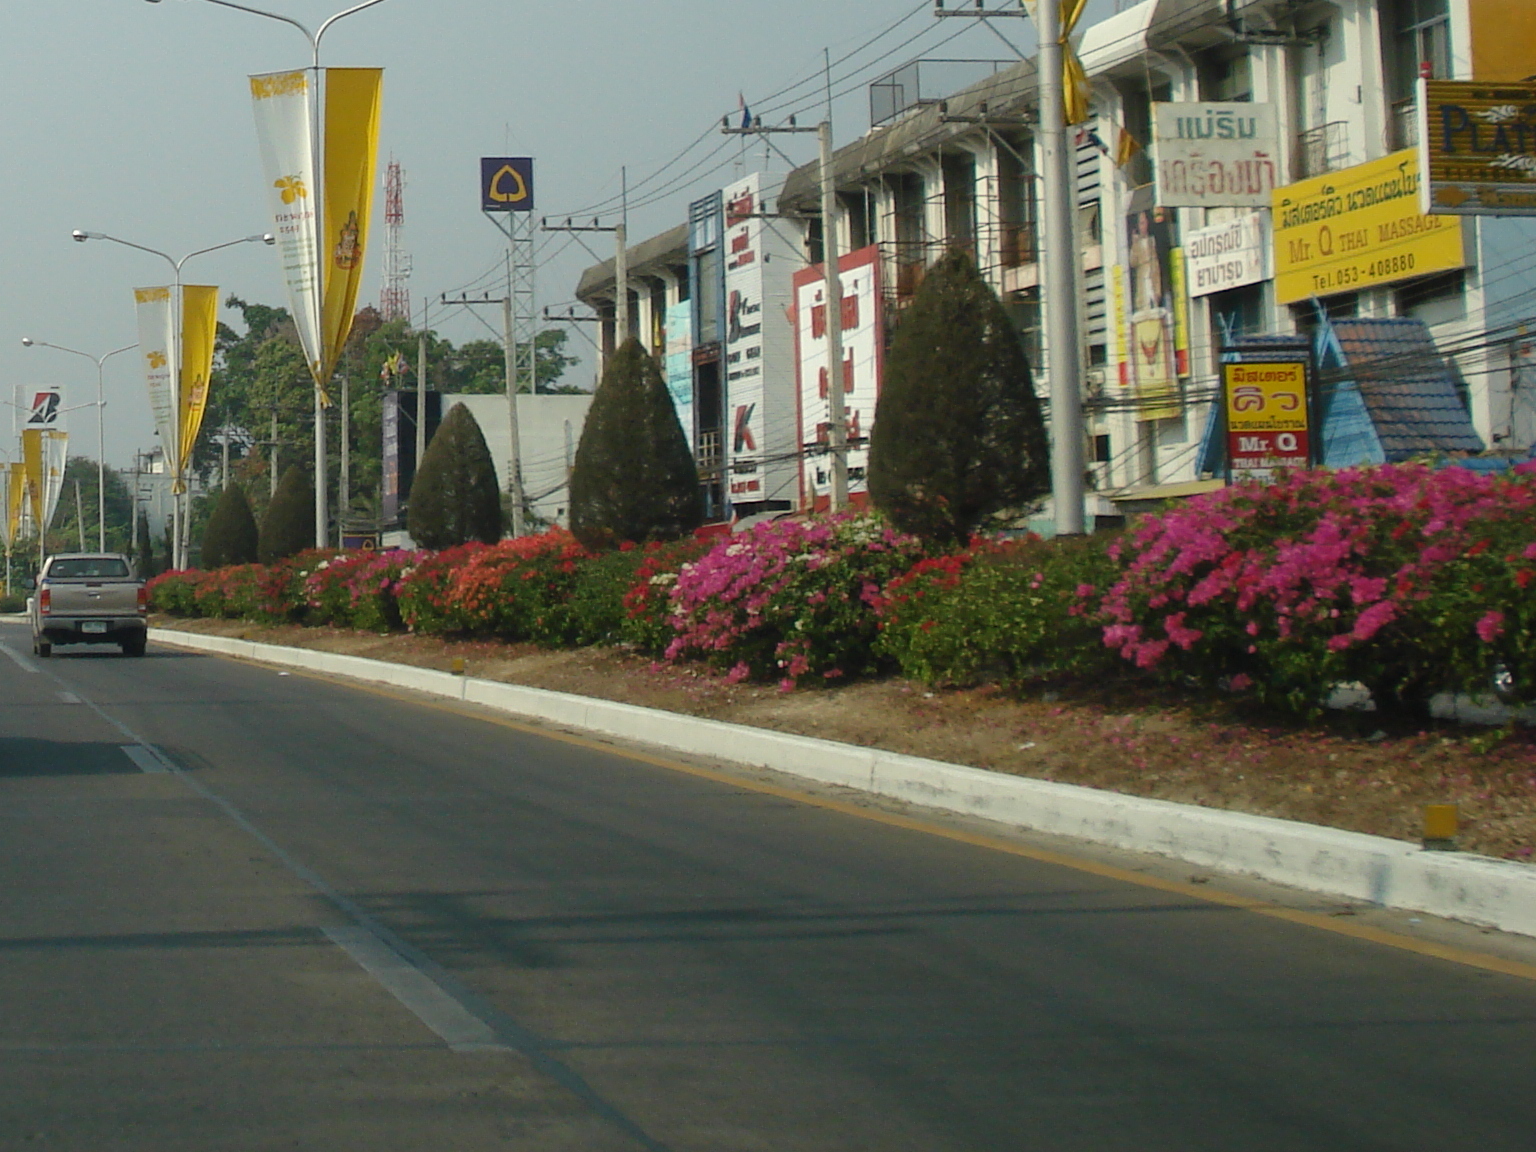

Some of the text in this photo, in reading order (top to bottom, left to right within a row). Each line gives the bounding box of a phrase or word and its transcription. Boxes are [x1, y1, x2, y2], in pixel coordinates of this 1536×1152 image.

[1346, 160, 1421, 212] นวดแผนโบ
[1289, 214, 1443, 263] Mr. Q THAI MASSAGE
[1233, 385, 1301, 412] คิว
[1238, 432, 1299, 452] Mr. Q
